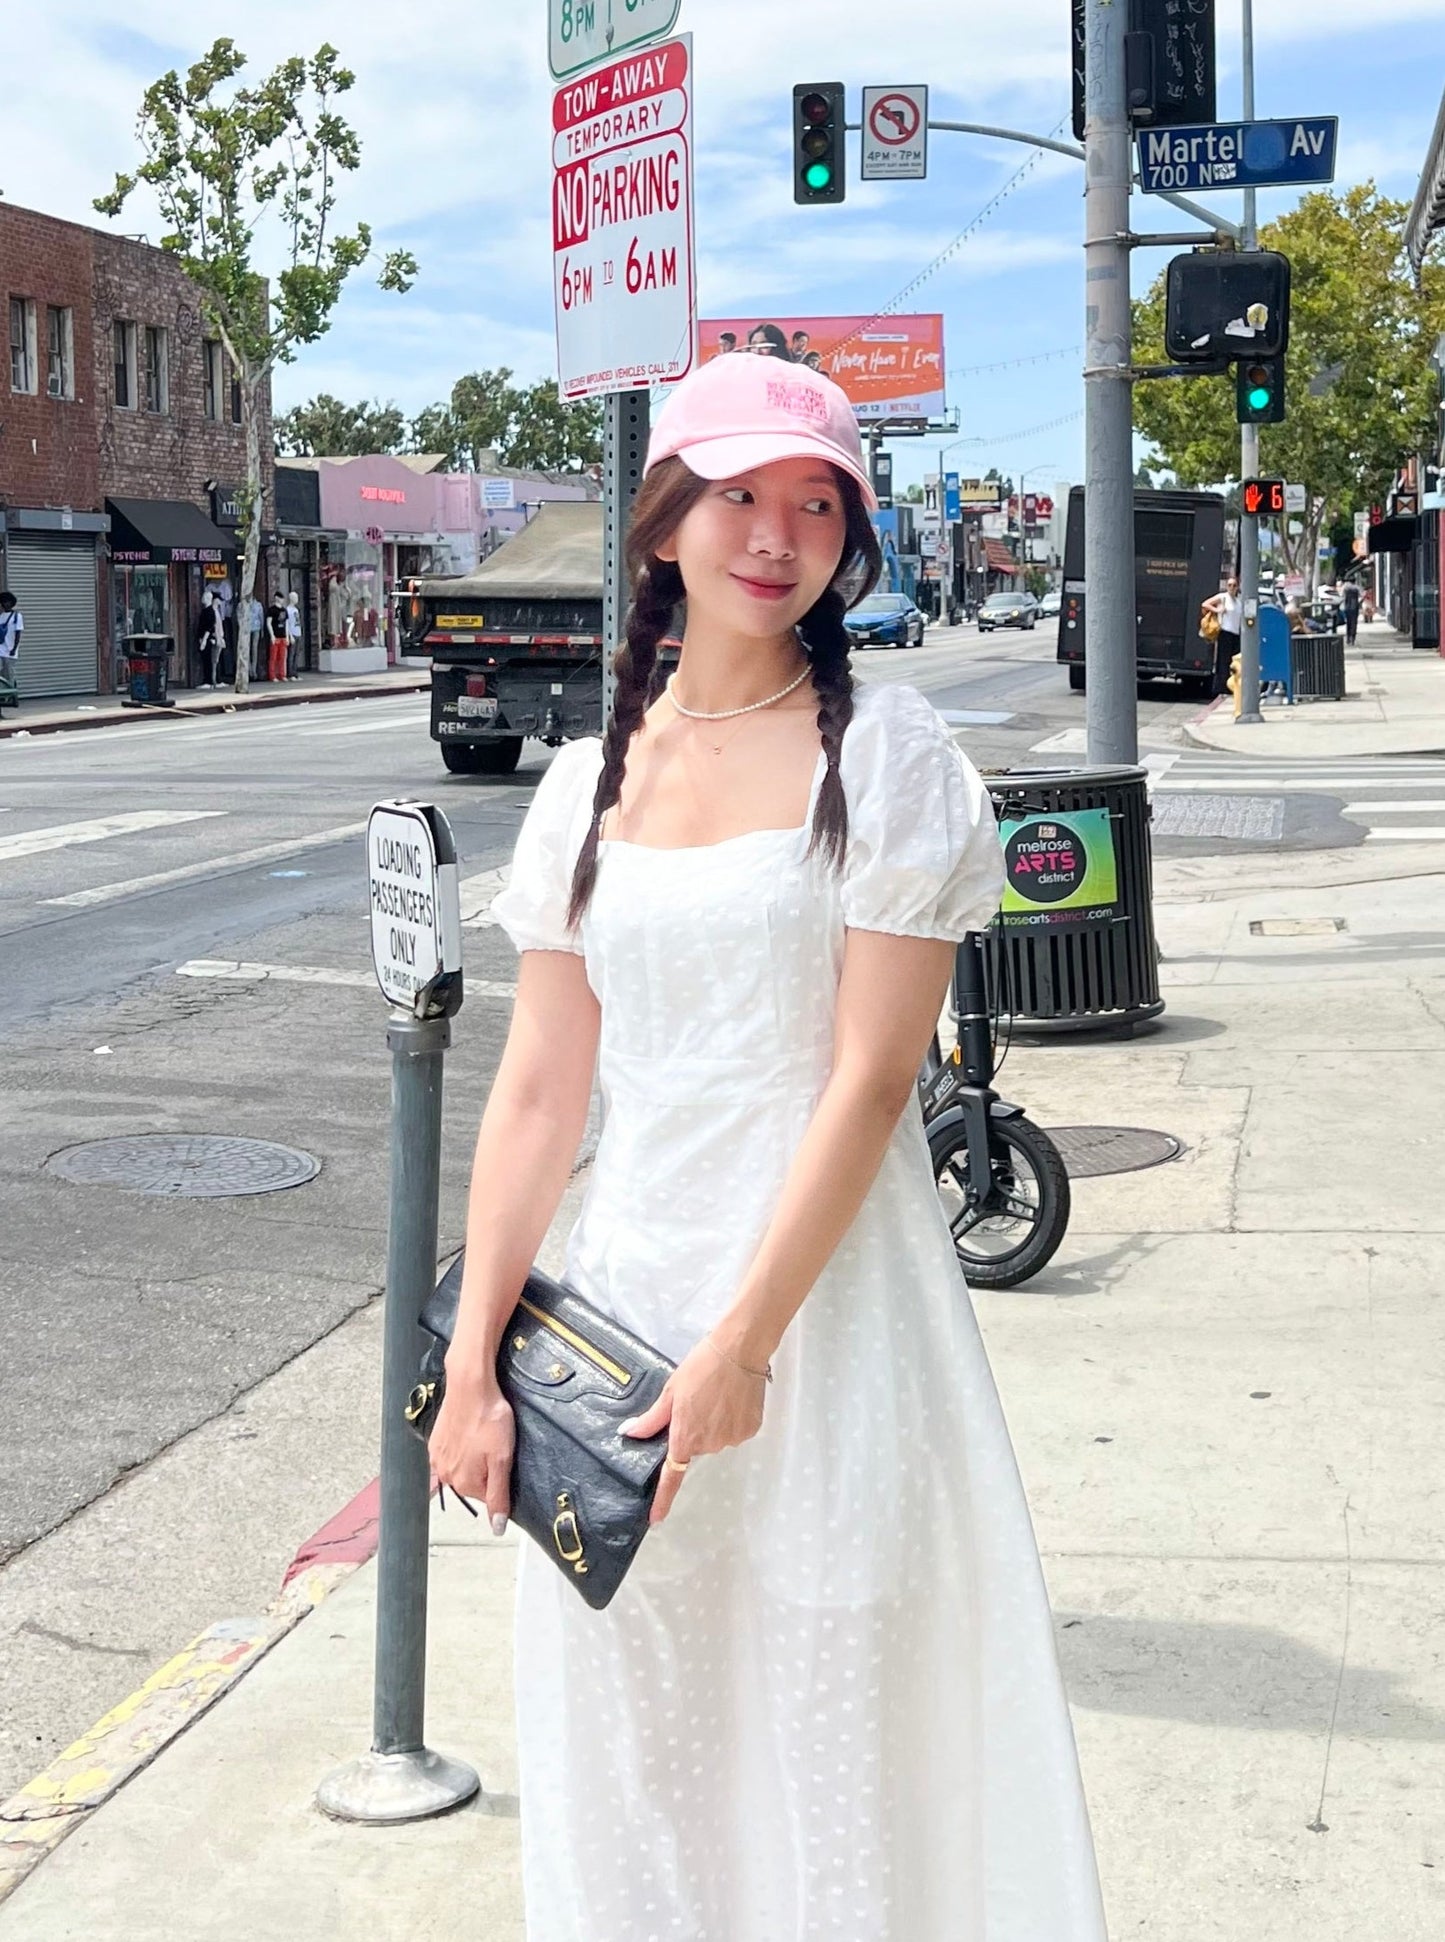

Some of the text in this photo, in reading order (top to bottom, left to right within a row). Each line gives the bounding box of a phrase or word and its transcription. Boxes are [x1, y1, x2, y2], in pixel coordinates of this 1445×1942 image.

[561, 0, 595, 43] 8PM
[563, 53, 668, 122] TOW-AWAY
[566, 100, 663, 157] TEMPORARY
[867, 151, 890, 161] 4PM
[899, 150, 921, 160] 7PM
[1148, 124, 1325, 165] Martel Av
[1148, 165, 1189, 188] 700
[557, 149, 679, 243] NO PARKING
[562, 235, 677, 311] 6PM TO 6AM
[615, 365, 646, 380] VEHICLES
[648, 362, 666, 374] CALL
[668, 360, 679, 372] 311
[832, 349, 868, 374] Never
[869, 347, 897, 373] Have
[889, 403, 920, 412] NETFLIX
[1271, 484, 1283, 510] 6
[171, 548, 222, 562] PSYCHIC ANGELS
[377, 836, 421, 879] LOADING
[1017, 840, 1073, 853] melrose
[1014, 851, 1076, 873] ARTS
[1037, 871, 1075, 884] district
[372, 879, 433, 928] PASSENGERS
[390, 927, 416, 967] ONLY
